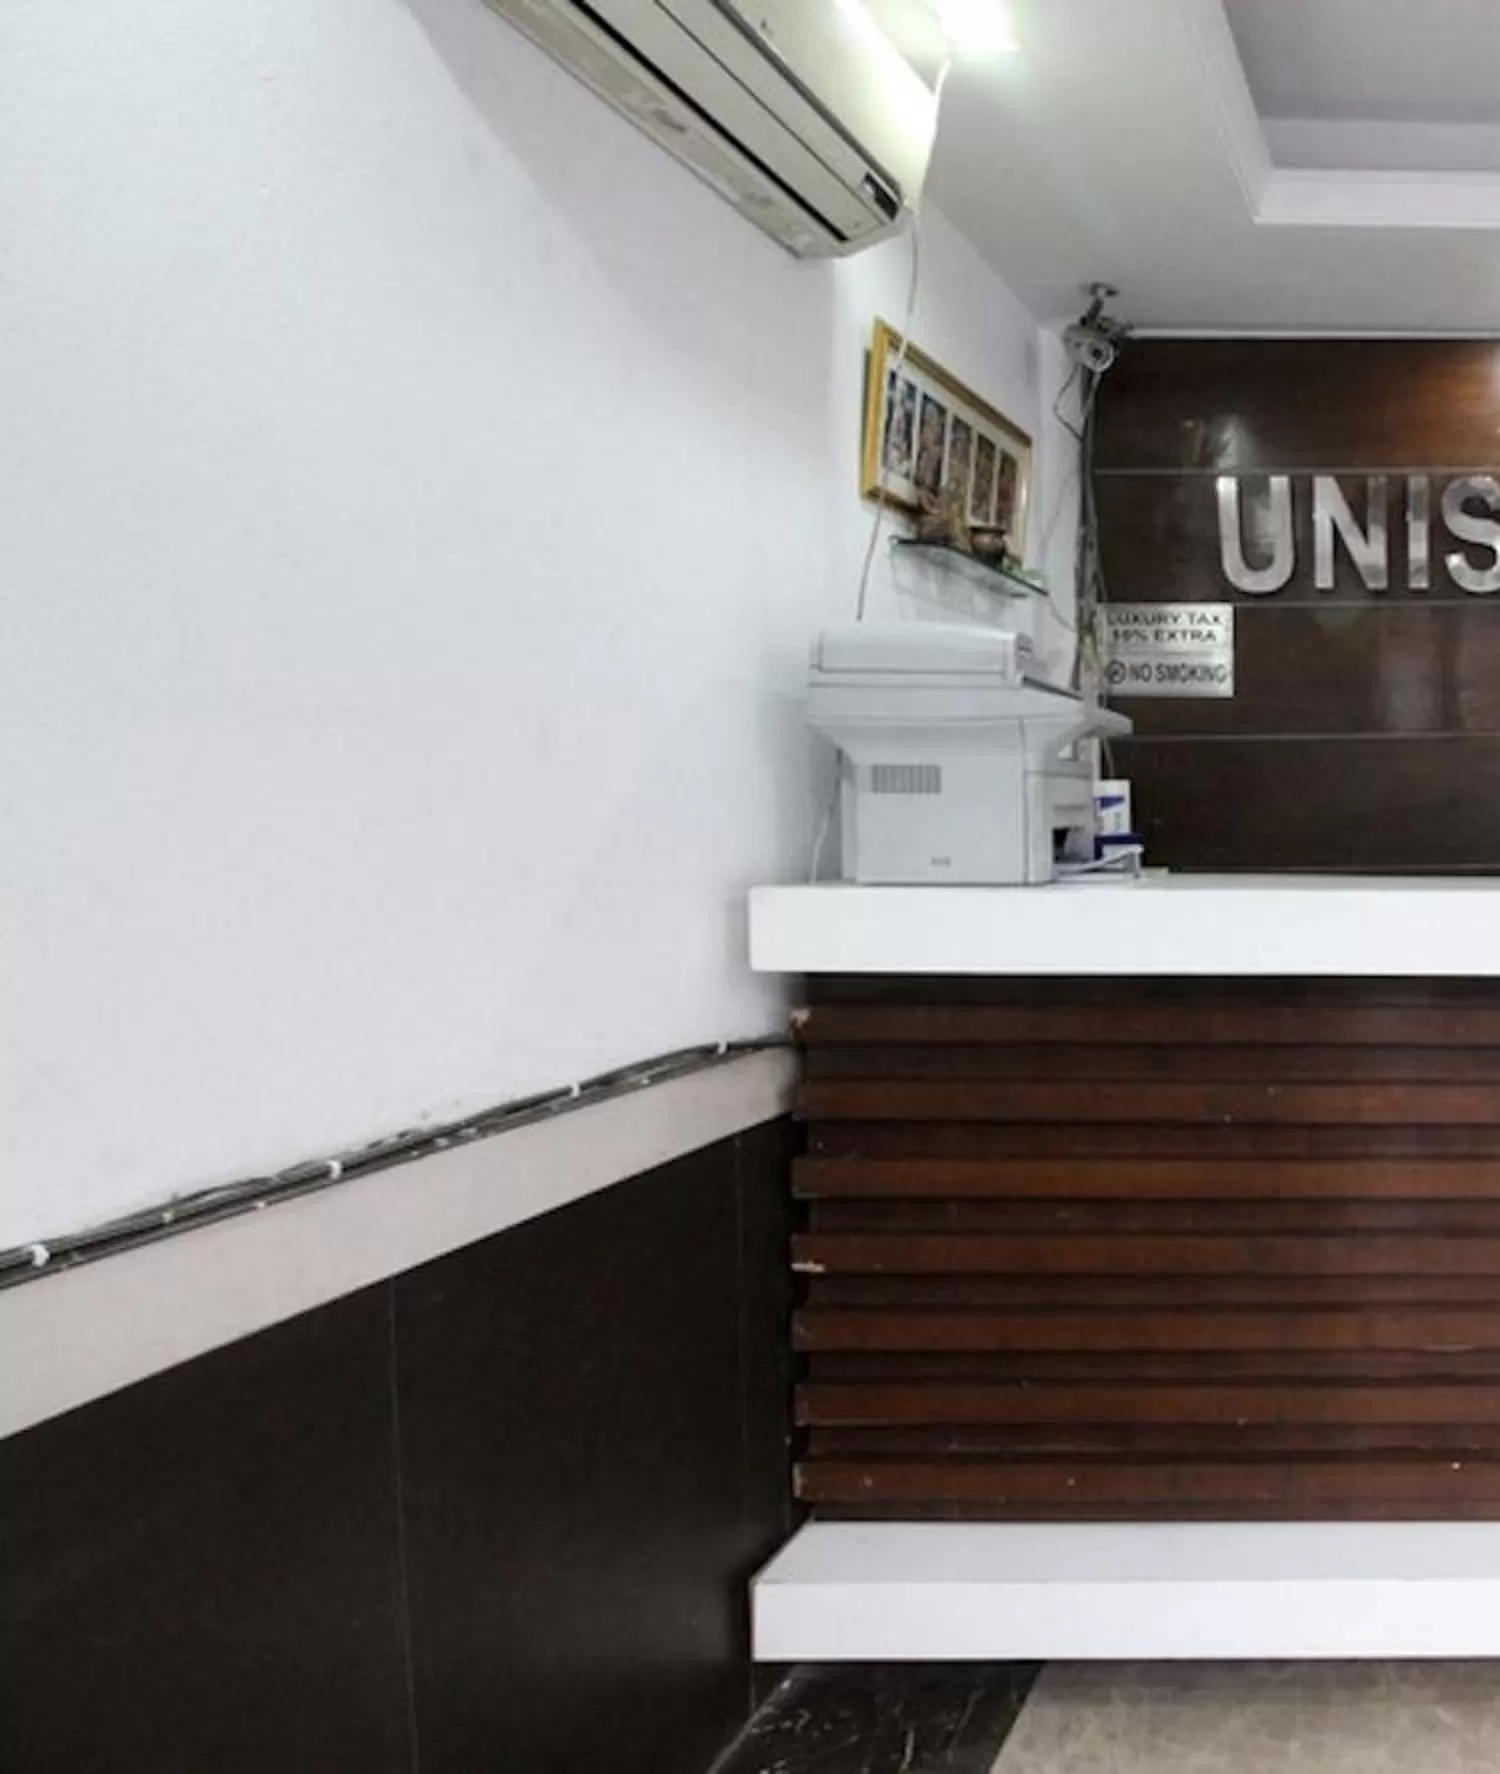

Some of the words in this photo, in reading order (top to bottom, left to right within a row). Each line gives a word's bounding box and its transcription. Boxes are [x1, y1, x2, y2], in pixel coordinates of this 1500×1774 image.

[1106, 612, 1182, 626] LUXURY
[1188, 612, 1224, 626] TAX
[1154, 628, 1217, 642] EXTRA
[1129, 662, 1151, 683] NO
[1155, 662, 1230, 684] SMOKING
